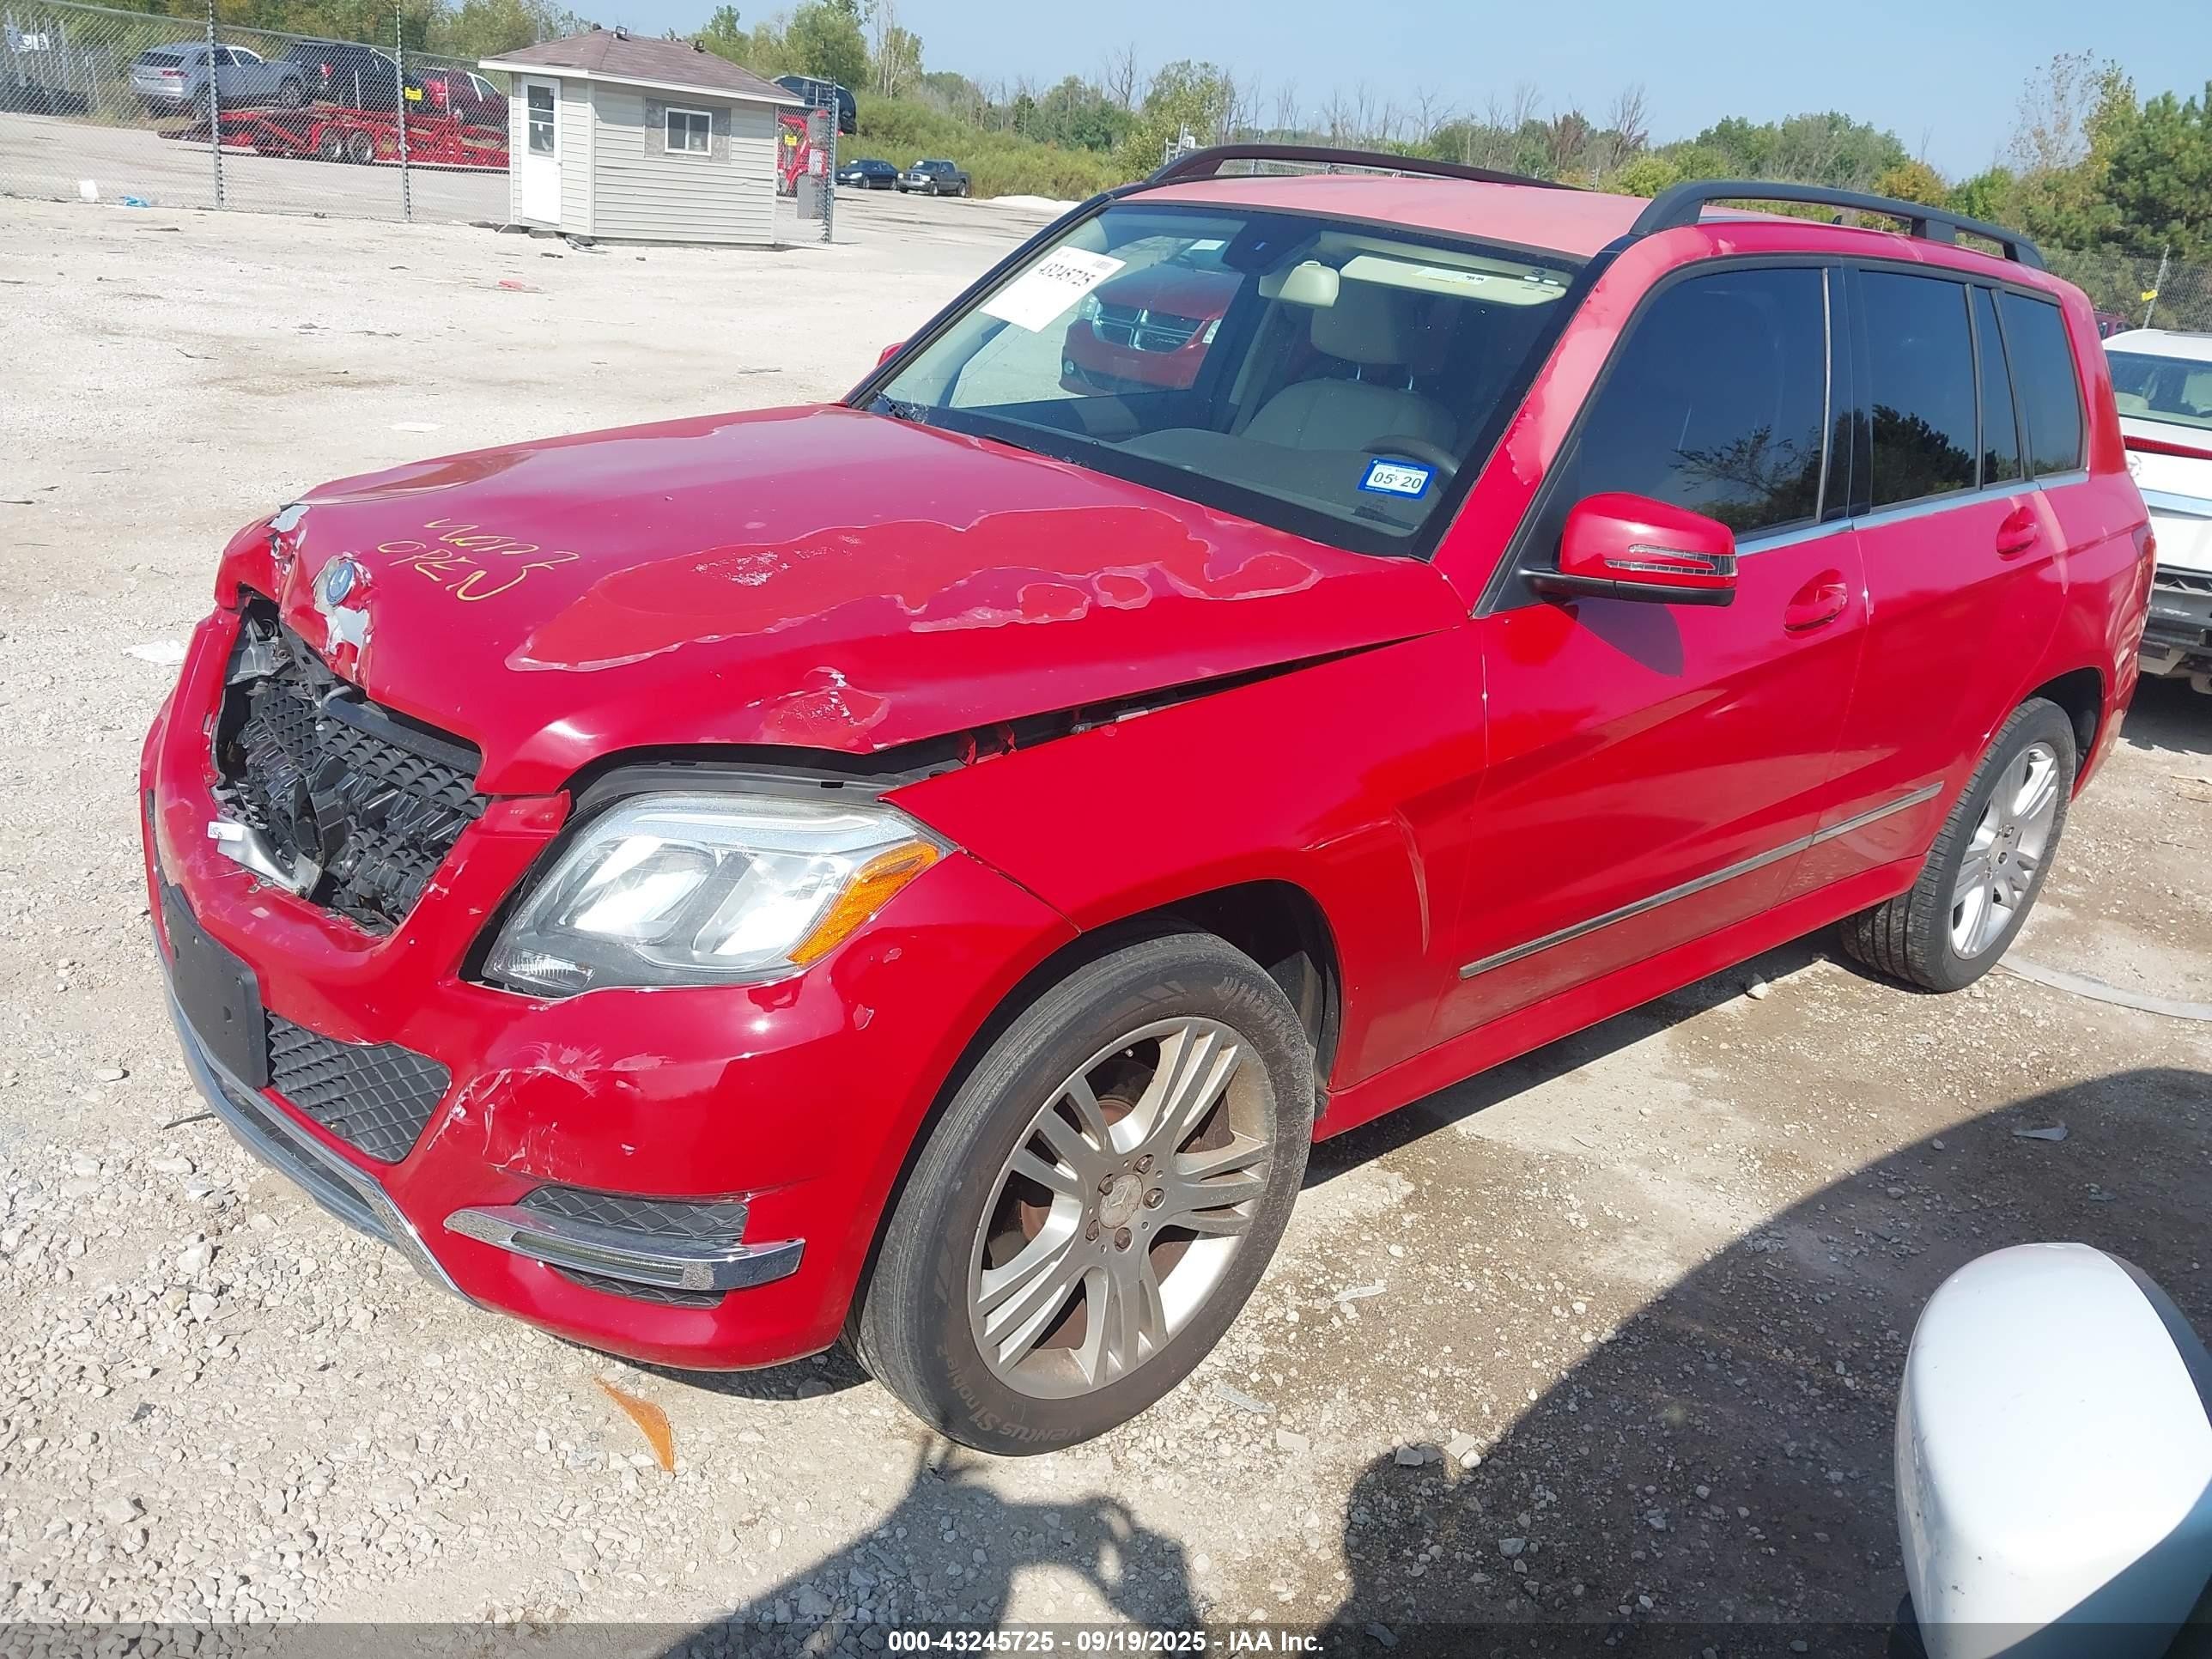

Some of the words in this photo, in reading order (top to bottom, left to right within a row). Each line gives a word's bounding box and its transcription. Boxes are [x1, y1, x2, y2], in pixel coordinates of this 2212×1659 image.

[1373, 471, 1395, 484] 05
[1401, 476, 1422, 489] 20
[377, 540, 527, 601] OPEN
